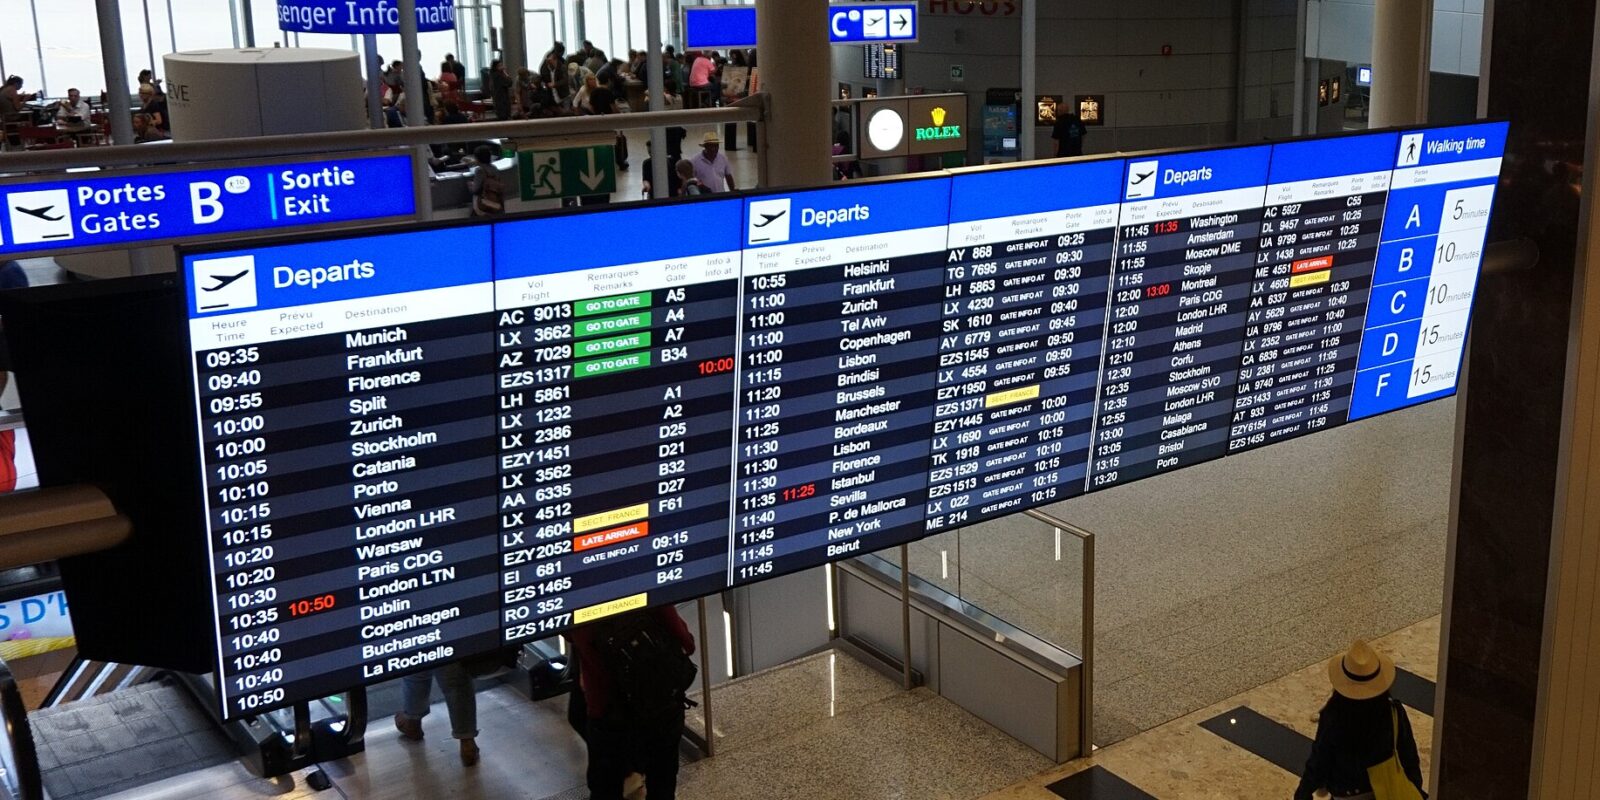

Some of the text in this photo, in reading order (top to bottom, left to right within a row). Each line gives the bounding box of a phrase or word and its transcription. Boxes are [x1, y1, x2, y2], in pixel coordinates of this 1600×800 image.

[832, 12, 848, 37] C
[916, 126, 960, 140] ROLEX
[1427, 137, 1485, 154] Walking time
[1164, 166, 1212, 185] Departs
[78, 183, 165, 206] Portes
[190, 182, 223, 224] B
[282, 166, 354, 190] Sortie
[81, 194, 330, 234] Gates Exit
[802, 204, 869, 227] Departs
[1125, 195, 1362, 238] 11:45 11:35 Washington AC 5927 C55
[1405, 204, 1420, 229] A
[845, 241, 889, 254] Destination
[1187, 229, 1234, 245] Amsterdam
[751, 232, 1085, 290] 10:55 Helsinki AY 868 09:25
[758, 253, 832, 269] Time Expected
[1185, 241, 1241, 260] Moscow DME
[1398, 248, 1413, 272] B
[274, 259, 375, 289] Departs
[527, 262, 689, 289] Vol Remarques Porte
[1183, 262, 1212, 276] Skopje
[521, 272, 686, 302] Flight Remarks Gate
[843, 277, 895, 296] Frankfurt
[1147, 275, 1217, 297] 13:00 Montreal
[841, 298, 878, 315] Zurich
[1179, 289, 1223, 307] Paris CDG
[1391, 290, 1406, 314] C
[212, 318, 247, 330] Heure
[345, 304, 407, 320] Destination
[840, 315, 887, 333] Tel Aviv
[1177, 303, 1228, 322] London LHR
[206, 287, 686, 368] 09:35 Munich AC 9013 GO TO GATE A5
[216, 322, 324, 343] Time Expected
[1175, 322, 1204, 337] Madrid
[208, 307, 685, 391] 09:40 Frankfurt LX 3662 A4
[839, 330, 911, 351] Copenhagen
[1172, 339, 1202, 352] Athens
[1382, 333, 1398, 356] D
[210, 327, 685, 414] 09:55 Florence AZ 7029 A7
[838, 353, 877, 369] Lisbon
[1171, 353, 1194, 367] Corfu
[837, 367, 880, 387] Brindisi
[1168, 365, 1211, 382] Stockholm
[1376, 373, 1391, 396] F
[836, 385, 885, 404] Brussels
[213, 395, 387, 436] 10:00 Split
[215, 358, 734, 458] 10:00 Zurich LH 5861 10:00
[835, 400, 901, 422] Manchester
[1162, 412, 1192, 426] Malaga
[834, 420, 888, 439] Bordeaux
[1160, 422, 1207, 440] Casablanca
[217, 431, 437, 481] 10:05 Stockholm
[833, 440, 871, 457] Lisbon
[1158, 439, 1185, 455] Bristol
[832, 455, 881, 474] Florence
[1156, 456, 1179, 469] Porto
[219, 455, 416, 502] 10:10 Catania
[742, 470, 875, 510] 11:35 11:25 Istanbul
[221, 480, 398, 524] 10:15 Porto
[830, 490, 867, 507] Sevilla
[829, 497, 906, 524] P. de Mallorca
[223, 499, 412, 546] 10:15 Vienna
[828, 518, 881, 541] New York
[224, 507, 456, 567] 10:20 London LHR
[827, 539, 860, 557] Beirut
[226, 537, 423, 588] 10:20 Warsaw
[228, 550, 443, 609] 10:30 Paris CDG
[230, 527, 640, 630] 10:35 10:50 London LTN LATE ARRIVAL
[232, 530, 689, 650] 10:40 Dublin EI 681 09:15
[233, 606, 460, 670] 10:40 Copenhagen
[235, 628, 441, 691] 10:40 Bucharest
[237, 645, 454, 710] 10:50 La Rochelle
